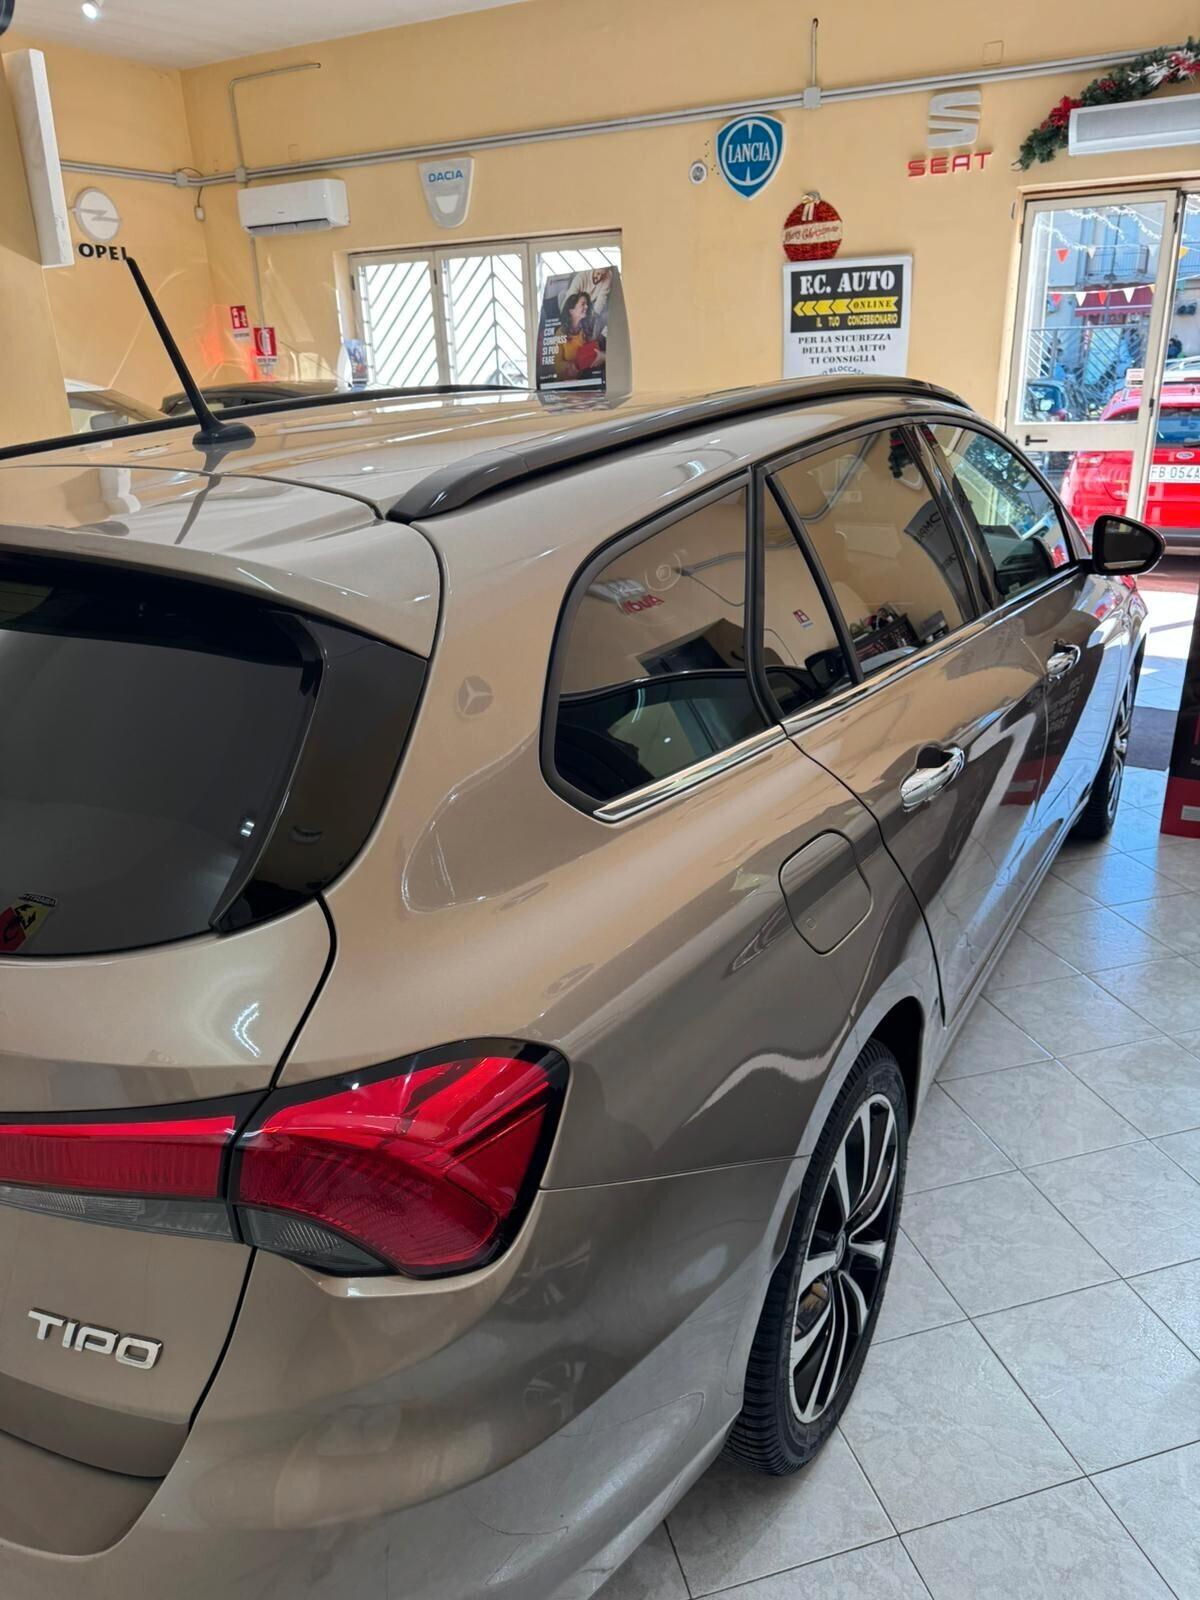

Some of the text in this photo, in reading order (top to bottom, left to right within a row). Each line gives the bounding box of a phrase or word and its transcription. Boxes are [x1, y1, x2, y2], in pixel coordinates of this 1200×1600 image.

[728, 142, 772, 163] LANCIA
[907, 152, 993, 177] SEAT
[428, 169, 464, 182] DACIA
[799, 270, 896, 294] F.C. AUTO
[853, 300, 892, 310] ONLINE
[798, 333, 892, 344] PER LA SICUREZZA
[802, 343, 886, 355] DELLA TUA AUTO
[809, 354, 877, 364] TI CONSIGLIA
[28, 1307, 164, 1370] TIPO
